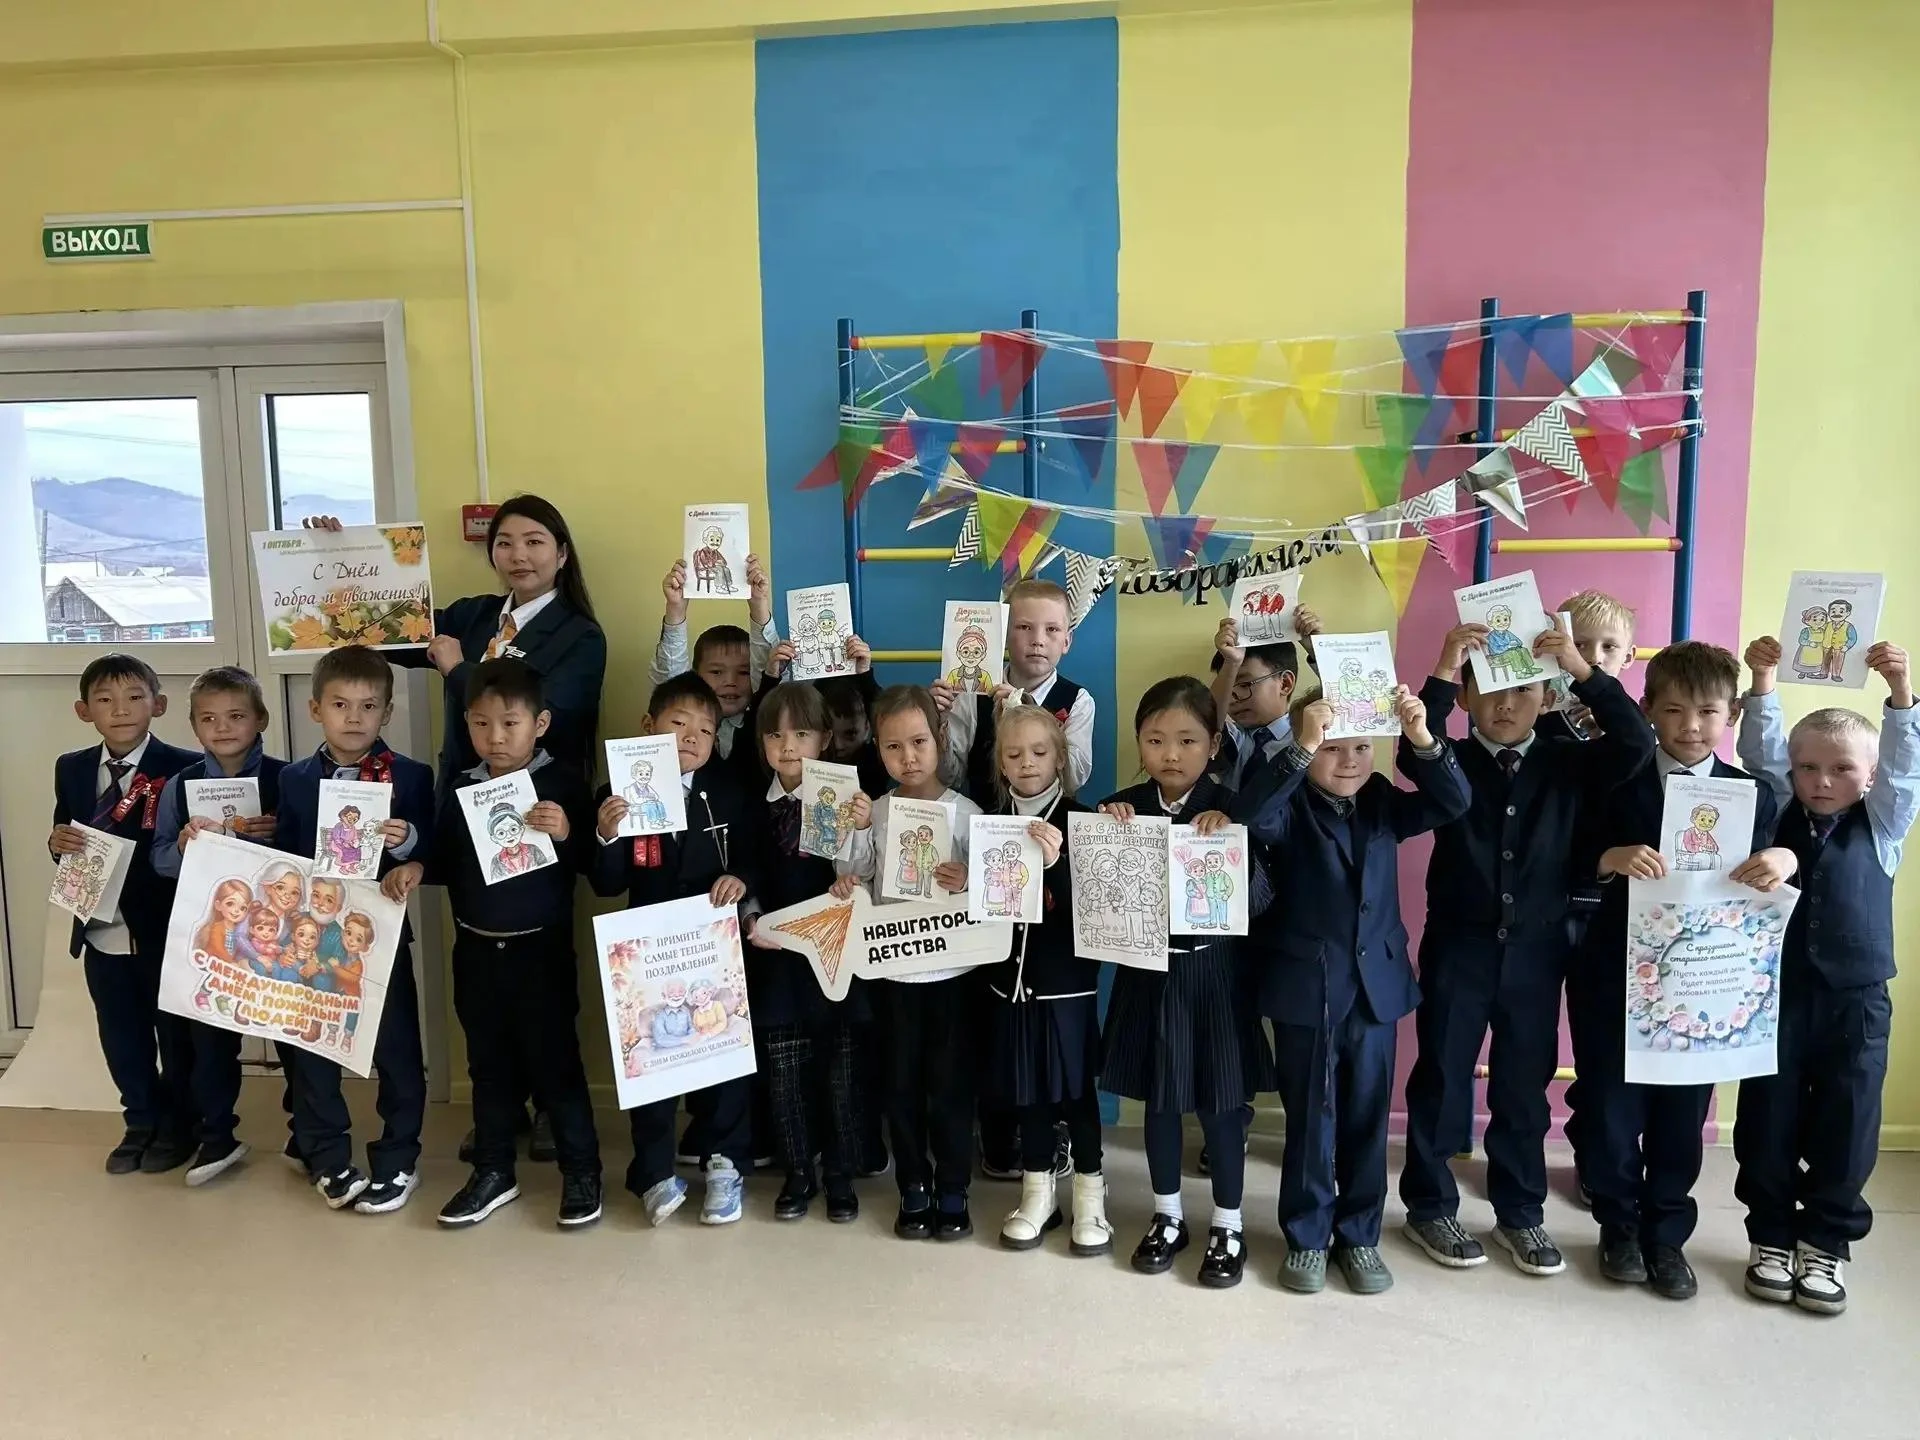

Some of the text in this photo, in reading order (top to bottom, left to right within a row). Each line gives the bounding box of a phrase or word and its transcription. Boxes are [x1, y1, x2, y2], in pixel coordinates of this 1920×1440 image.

[52, 228, 140, 252] ВЫХОД
[267, 539, 301, 549] ОКТЯБРЯ
[313, 561, 380, 580] С Днём
[274, 584, 425, 612] добра и уважения!
[1096, 822, 1141, 835] С ДНЕМ
[1073, 834, 1168, 850] БАБУШЕК И ДЕДУШЕК!
[656, 930, 701, 947] ПРИМИТЕ
[1686, 943, 1694, 951] С
[644, 941, 717, 964] САМЫЕ ТЕПЛЫЕ
[868, 936, 947, 964] ДЕТСТВА
[645, 954, 719, 979] ПОЗДРАВЛЕНИЯ!
[1670, 956, 1709, 966] старшего
[194, 952, 359, 1010] С МЕЖДУНАРОДНЫМ
[1673, 970, 1698, 979] Пусть
[1699, 968, 1729, 977] каждый
[1680, 980, 1704, 989] будет
[241, 1003, 310, 1029] ЛЮДЕЙ!
[262, 994, 341, 1023] ПОЖИЛЫХ
